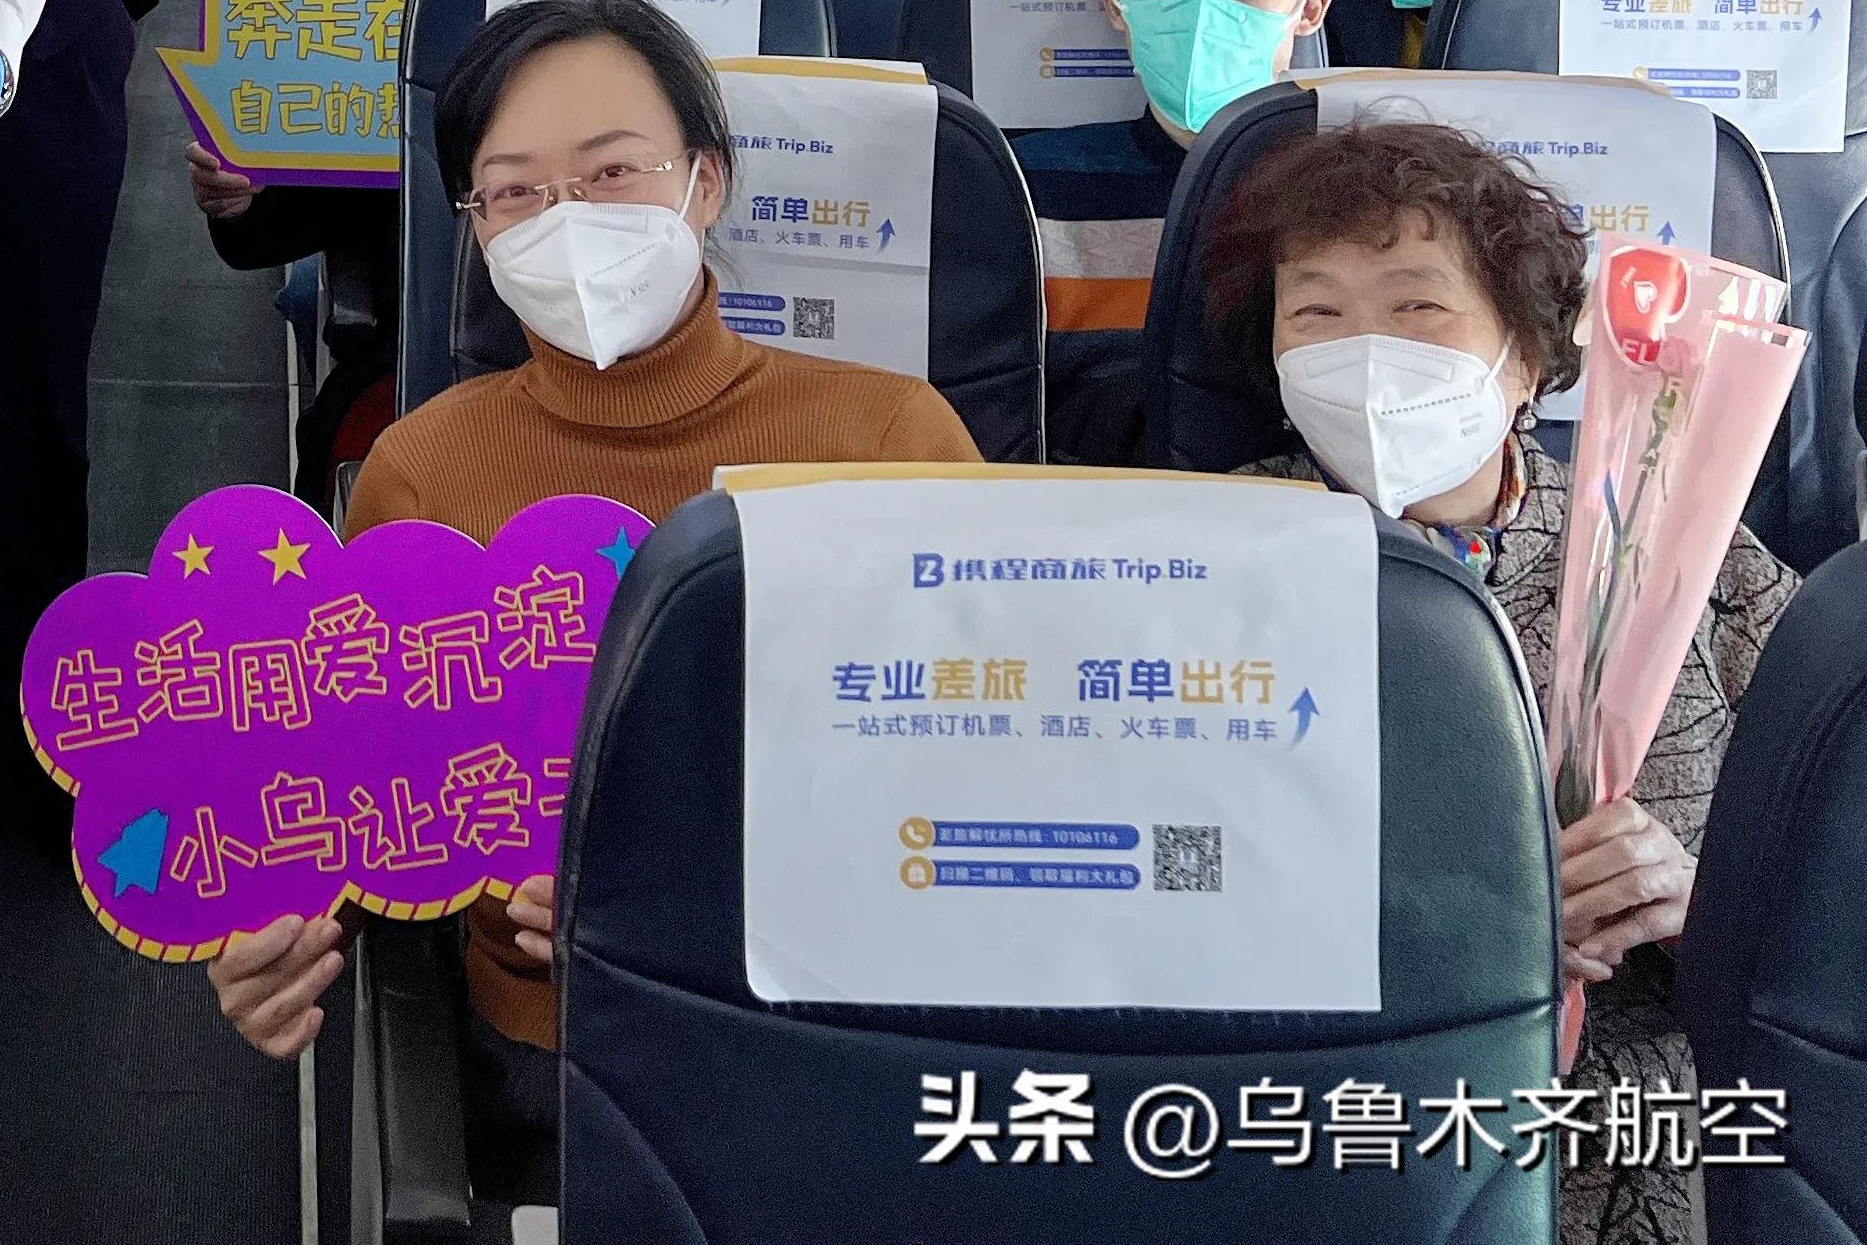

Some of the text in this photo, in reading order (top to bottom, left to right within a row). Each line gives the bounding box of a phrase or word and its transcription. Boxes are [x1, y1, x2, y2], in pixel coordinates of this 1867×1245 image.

[1548, 142, 1609, 158] Trip.Biz
[751, 195, 872, 228] 简单出行
[951, 556, 1209, 585] 携程商旅 Trip.Biz
[50, 564, 597, 752] 生活用爱沉淀
[832, 658, 1277, 705] 专业差旅 简单出行
